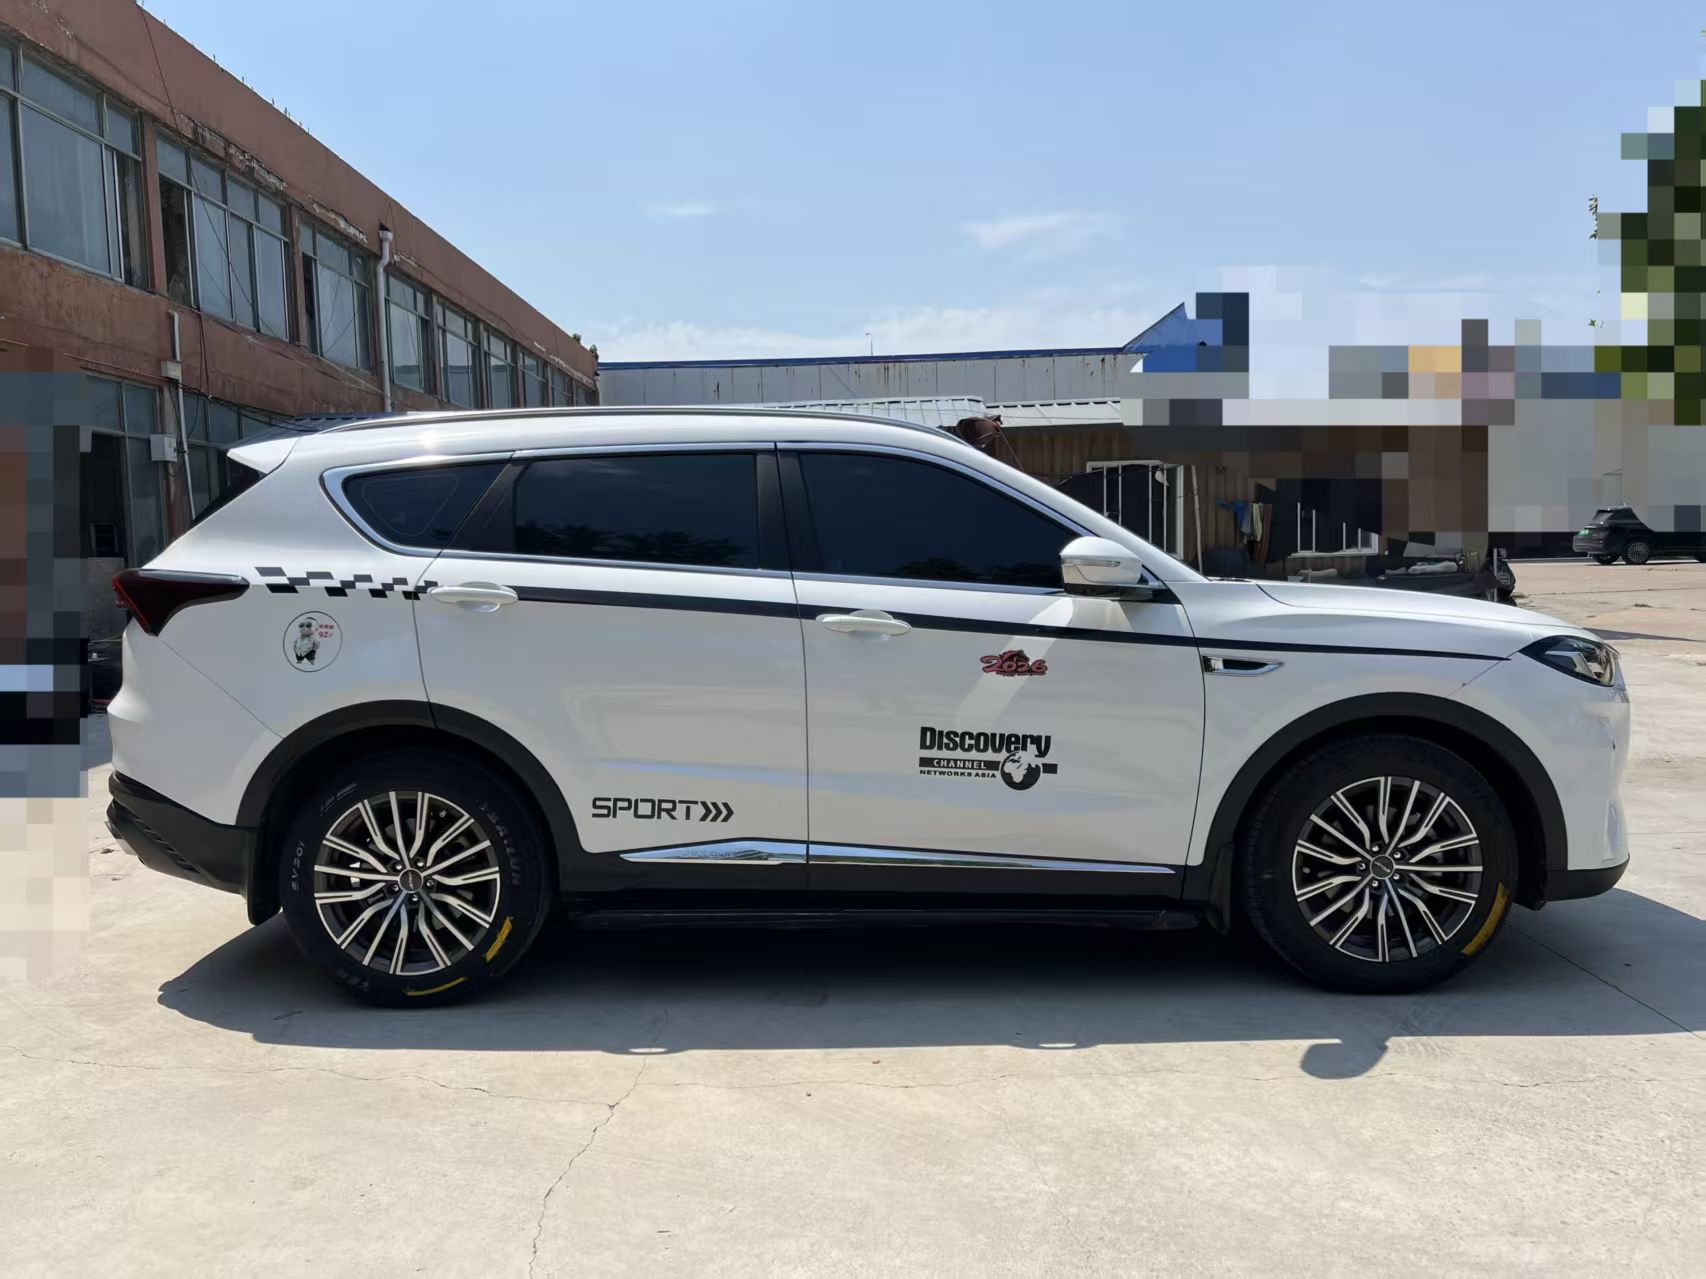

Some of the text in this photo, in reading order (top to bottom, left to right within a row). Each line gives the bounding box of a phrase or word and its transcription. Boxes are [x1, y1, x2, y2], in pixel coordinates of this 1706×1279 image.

[980, 655, 1048, 673] 2026
[933, 759, 987, 769] CHANNEL
[919, 770, 973, 778] NETWORKS
[592, 797, 698, 820] SPORT
